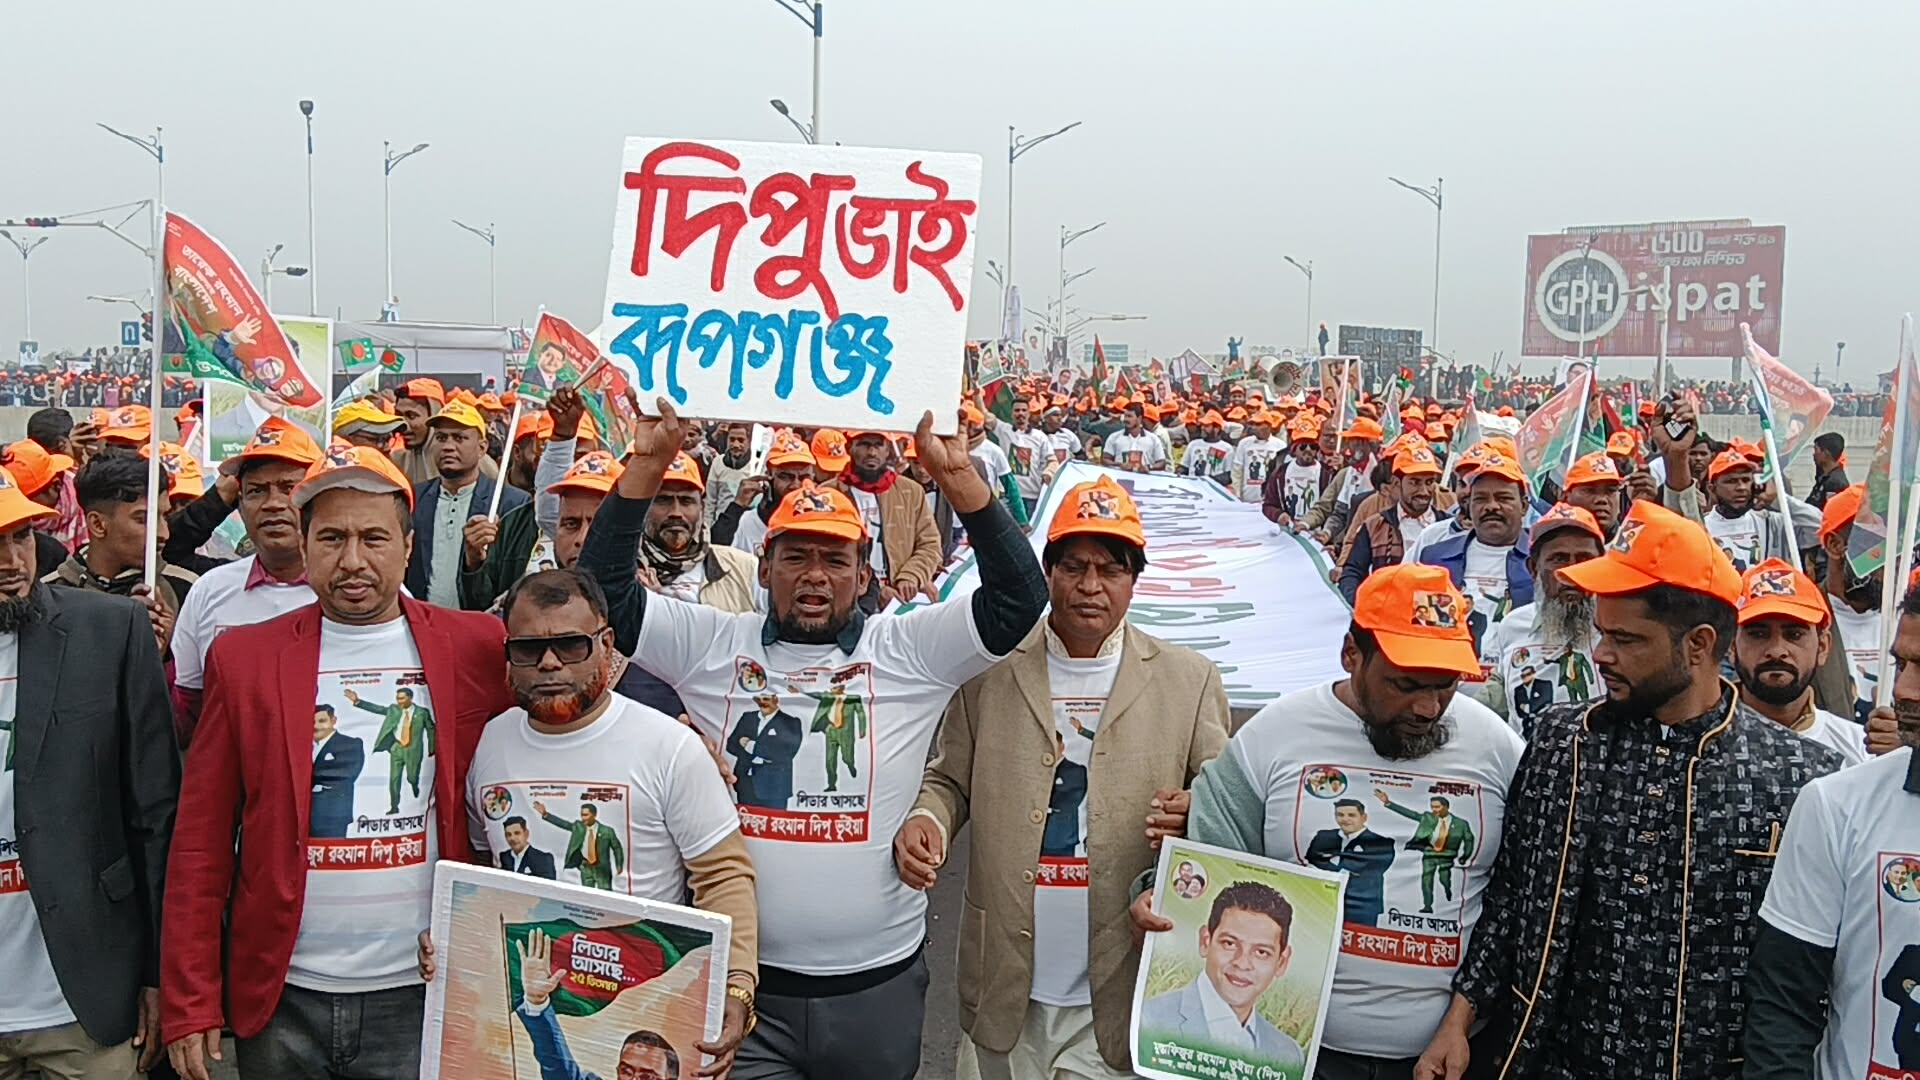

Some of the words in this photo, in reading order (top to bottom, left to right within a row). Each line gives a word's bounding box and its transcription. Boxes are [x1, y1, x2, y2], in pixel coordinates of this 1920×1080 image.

[174, 264, 219, 315] বাংলাদেশ
[214, 279, 244, 317] রহমান
[1545, 279, 1613, 317] GPH
[796, 790, 829, 808] লিডার
[831, 794, 866, 809] আসছে
[356, 815, 390, 834] লিডার
[392, 814, 425, 833] আসছে
[770, 816, 806, 838] রহমান
[809, 813, 833, 841] দিপু
[328, 845, 368, 864] রহমান
[370, 839, 394, 865] দিপু
[1060, 864, 1089, 882] রহমা
[1388, 907, 1424, 930] লিডার
[1426, 917, 1459, 934] আসছে
[572, 933, 621, 962] লিডার
[1357, 931, 1400, 957] রহমান
[1402, 934, 1428, 964] দিপু
[570, 971, 585, 985] ২৫
[1196, 1050, 1228, 1068] রহমান
